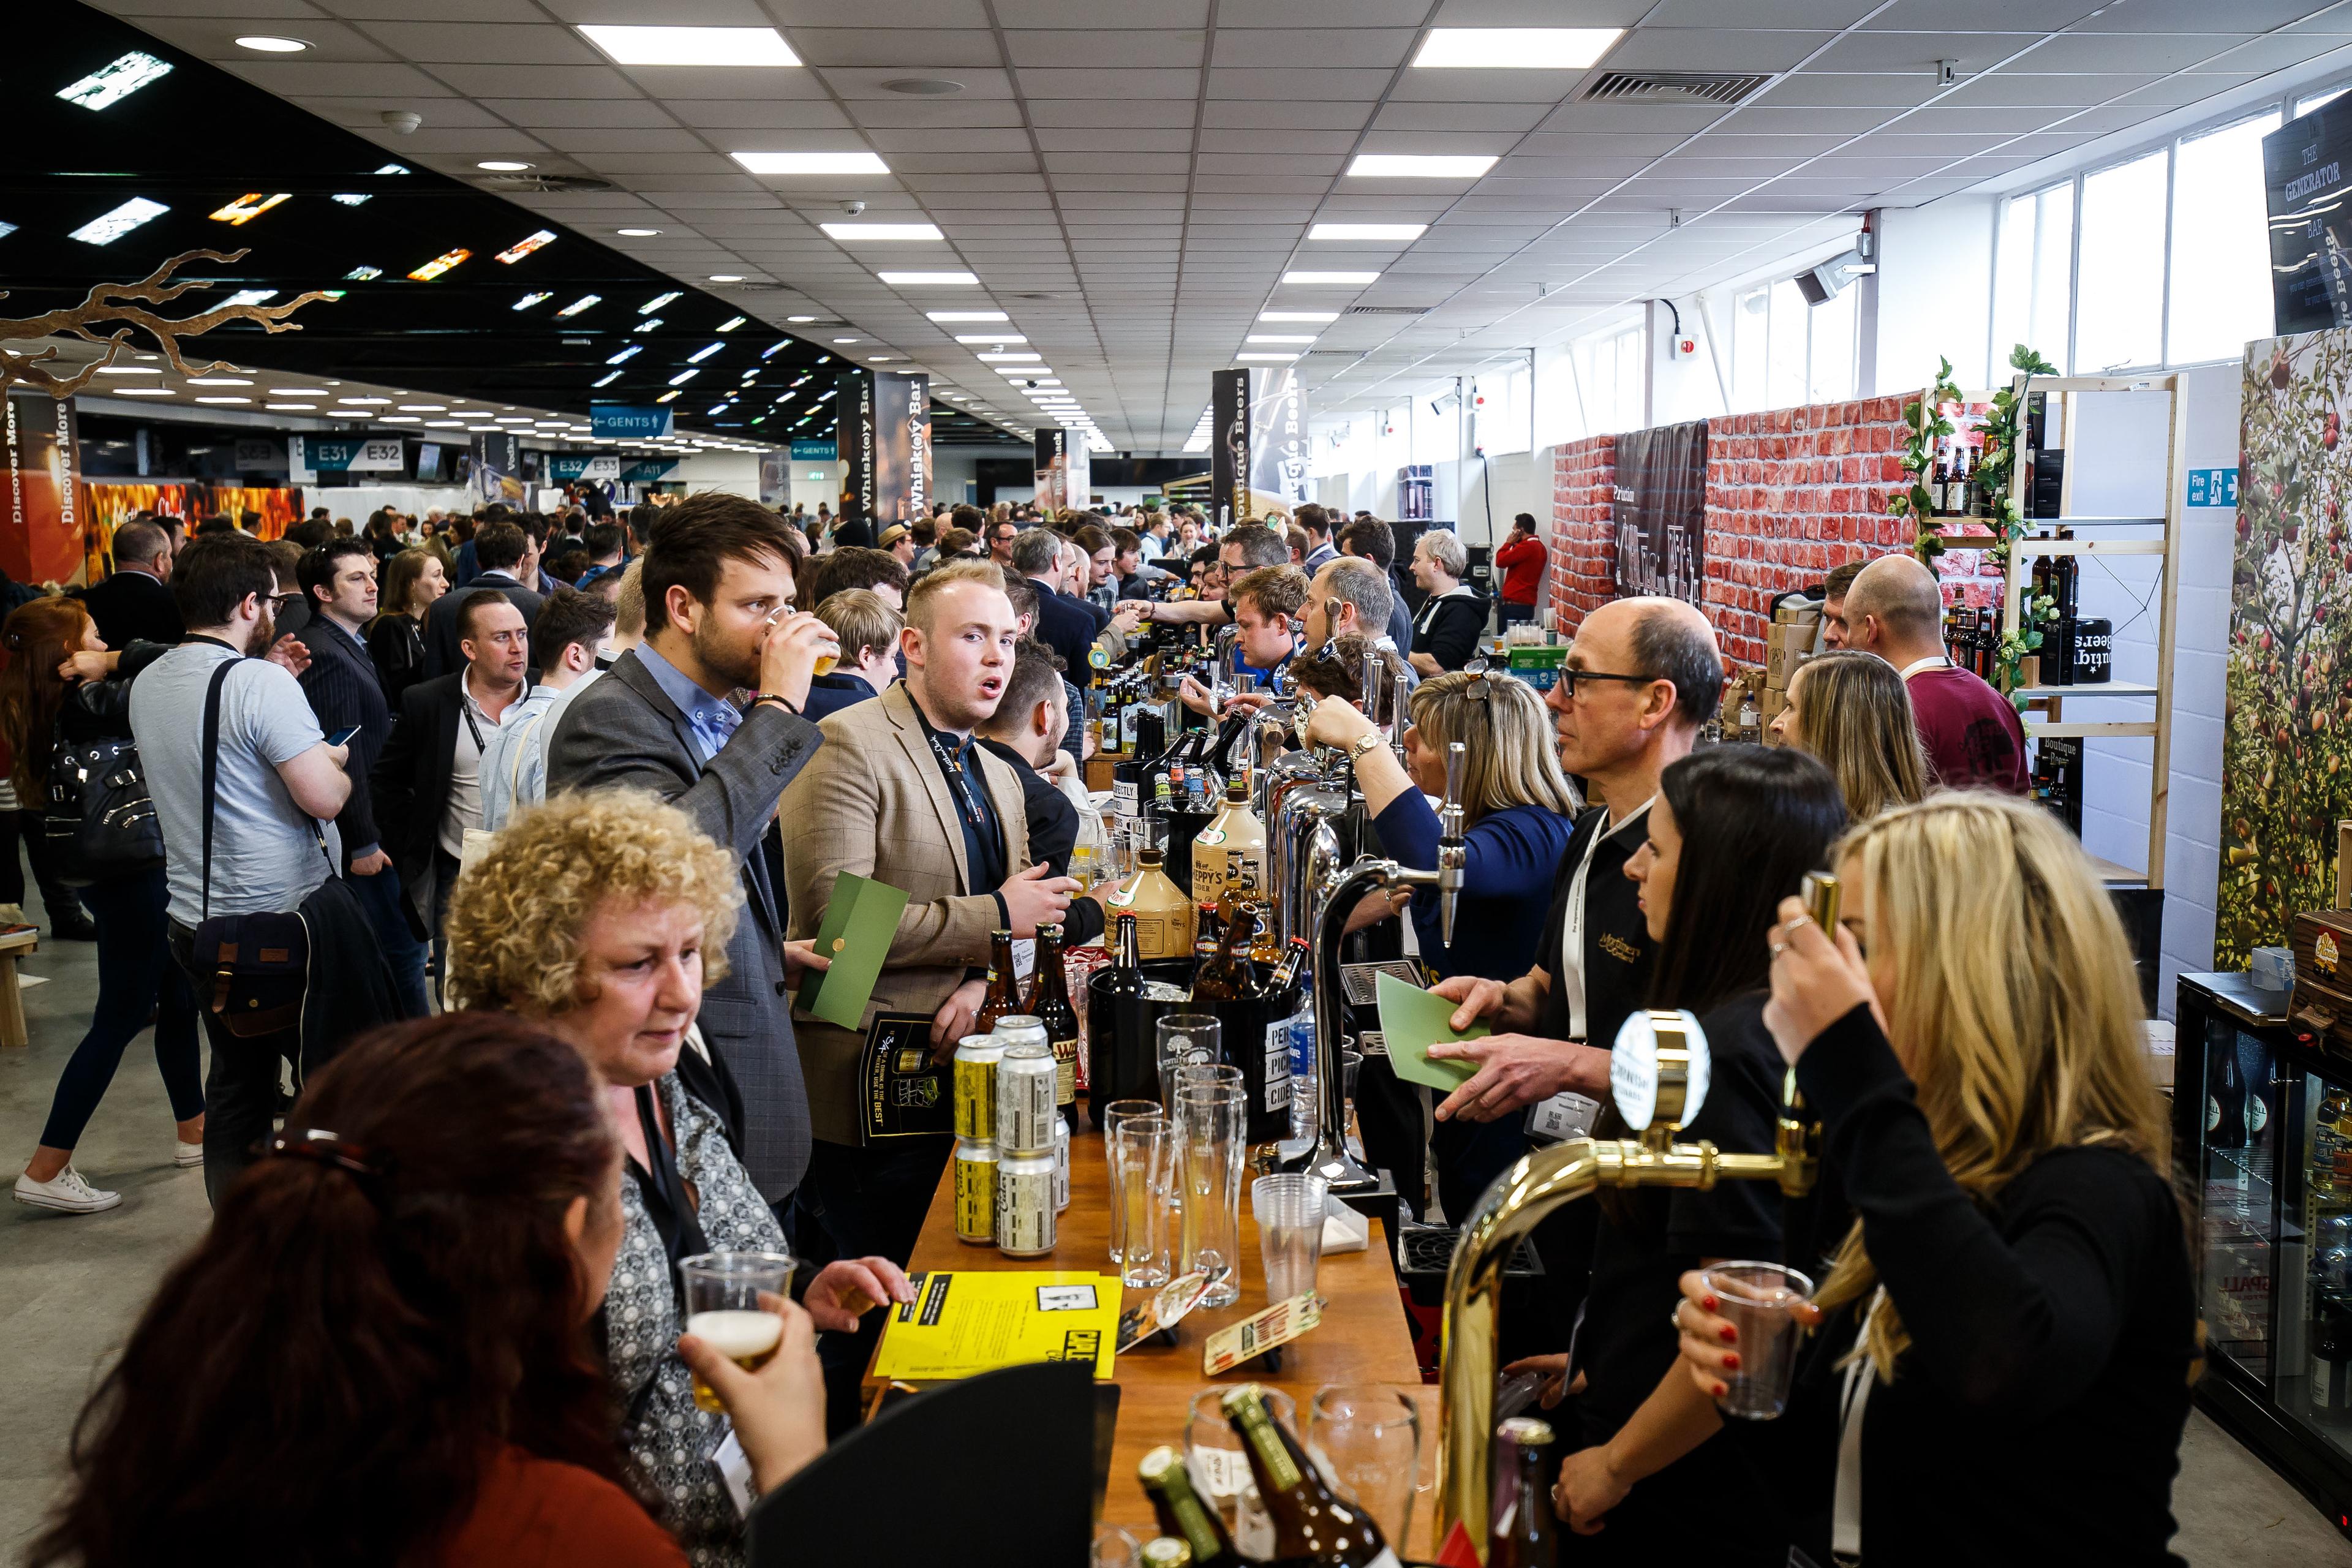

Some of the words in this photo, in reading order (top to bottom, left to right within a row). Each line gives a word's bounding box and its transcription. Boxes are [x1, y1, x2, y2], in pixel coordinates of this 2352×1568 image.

[2302, 143, 2318, 165] THE
[2285, 161, 2340, 202] GENERATOR
[2307, 218, 2323, 239] BAR
[861, 380, 869, 415] Bar
[909, 380, 921, 415] Bar
[1235, 377, 1244, 435] Beers
[1285, 377, 1298, 434] Beers
[6, 401, 17, 447] More
[56, 402, 70, 447] More
[608, 417, 649, 428] GENTS
[318, 445, 347, 461] E31
[368, 445, 399, 460] E32
[1053, 432, 1062, 466] Shack
[559, 461, 582, 472] E32
[594, 460, 616, 471] E33
[861, 419, 872, 512] Whisk(e)y
[910, 419, 925, 512] Whisk(e)y
[10, 449, 22, 524] Discover
[61, 450, 74, 524] Discover
[2192, 475, 2205, 487] Fire
[2192, 490, 2204, 502] exit
[2075, 635, 2113, 650] Beers
[1314, 746, 1325, 761] OLD
[1196, 942, 1218, 952] WESTONS
[878, 1036, 894, 1054] 3/4
